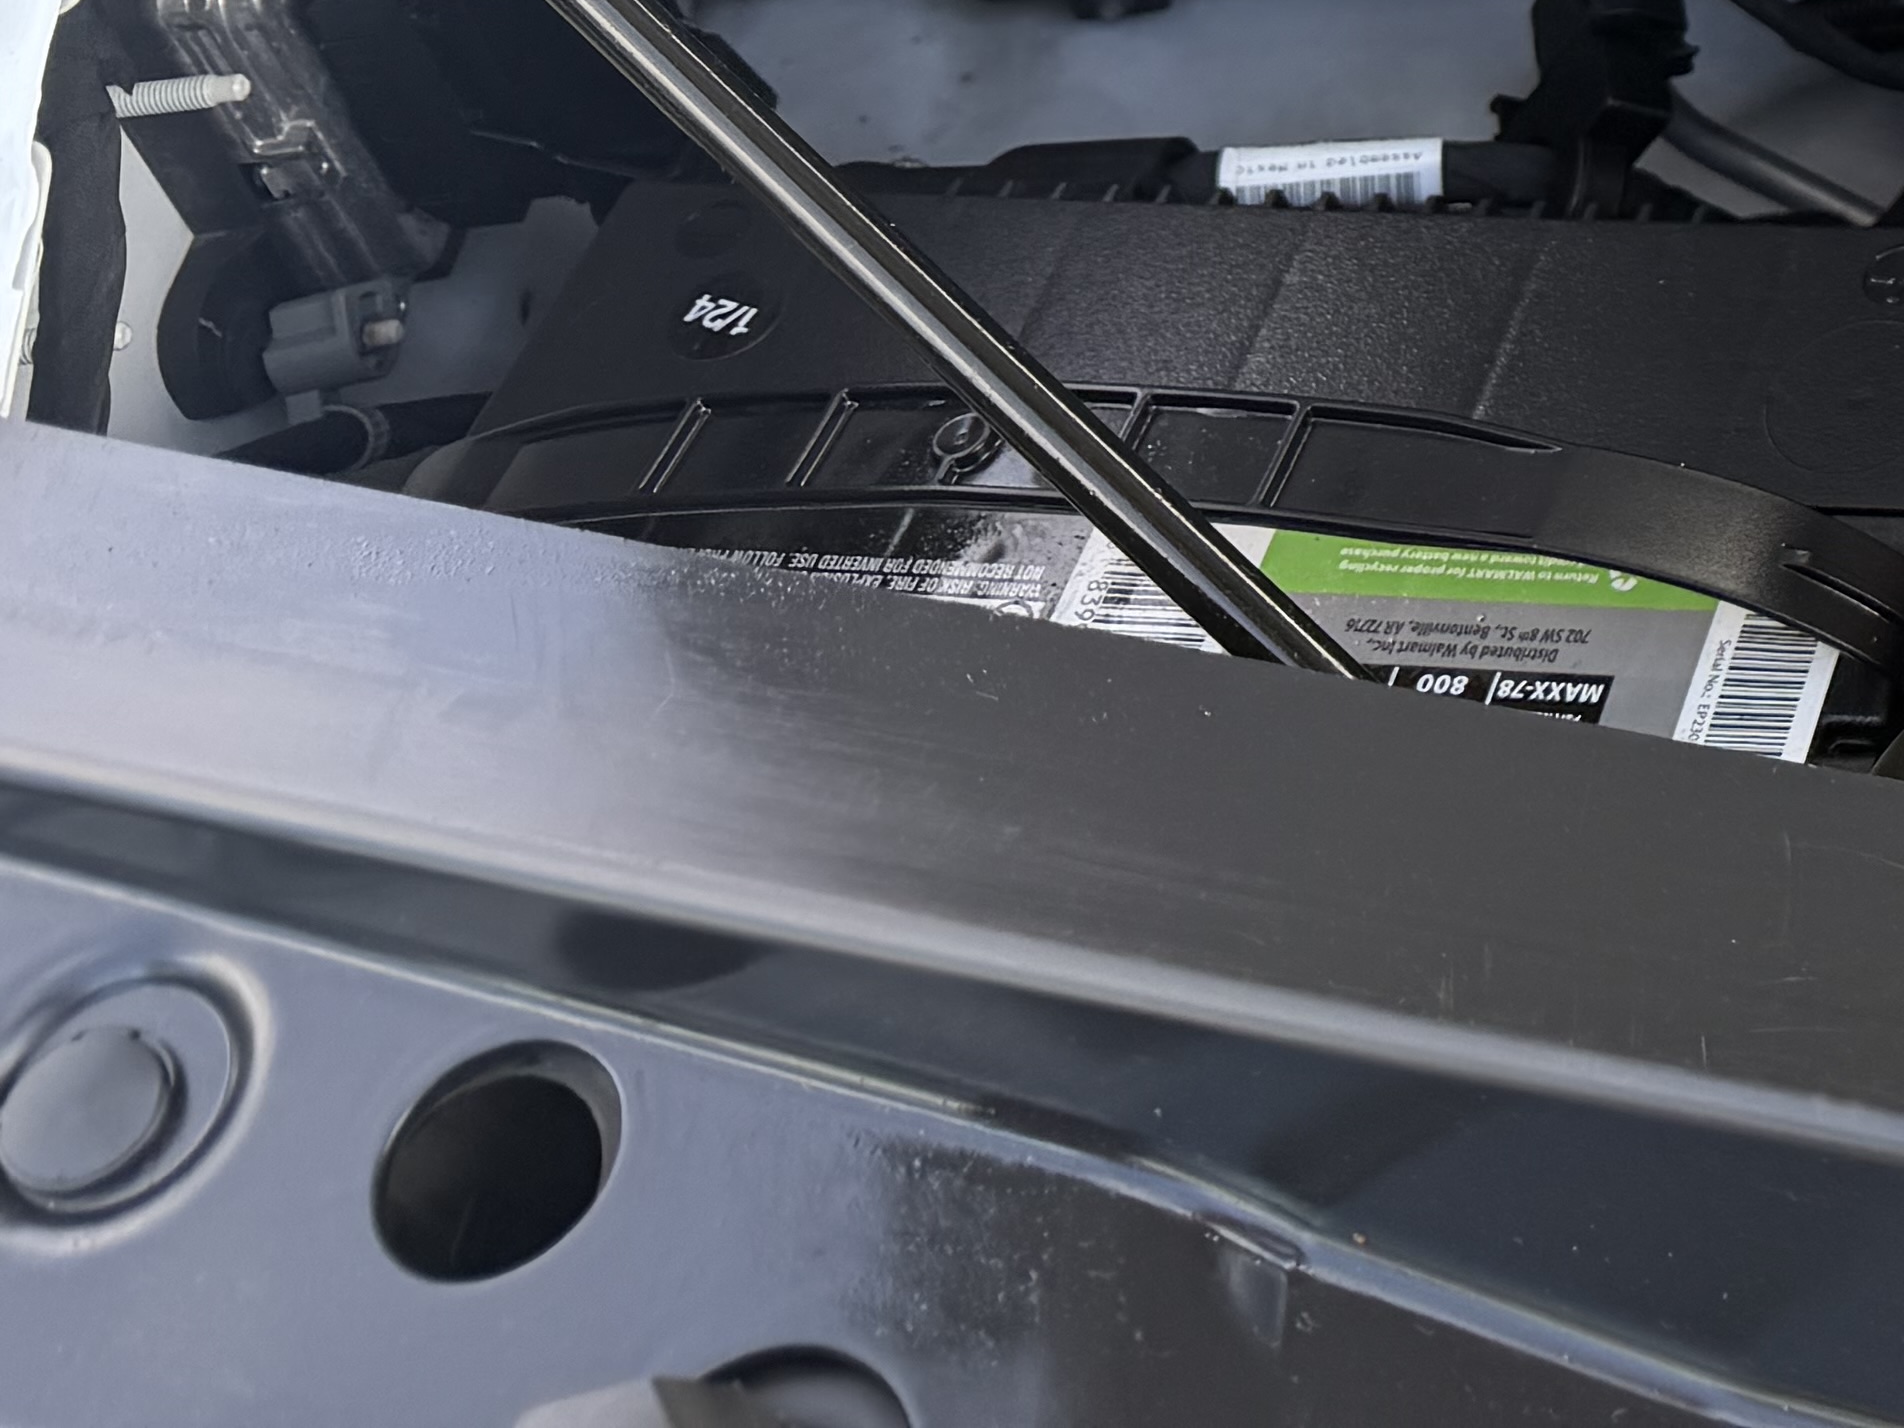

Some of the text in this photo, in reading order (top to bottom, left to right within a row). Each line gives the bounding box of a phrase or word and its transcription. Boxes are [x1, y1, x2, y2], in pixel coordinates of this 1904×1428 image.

[684, 293, 758, 336] 1/24
[886, 558, 911, 573] FOR
[913, 559, 1015, 578] RECOMMENDED
[1019, 565, 1045, 580] NOT
[1339, 559, 1599, 584] Return to WALMART for proper recycling
[920, 577, 937, 592] OF
[941, 578, 972, 594] RISK
[1345, 618, 1384, 634] 72716
[1386, 620, 1405, 635] AR
[1409, 621, 1491, 639] Bentonville,
[1540, 628, 1564, 642] SW
[1566, 628, 1592, 644] 702
[1397, 641, 1457, 657] Walmart
[1461, 642, 1477, 656] by
[1479, 645, 1559, 663] Distributed
[1712, 639, 1732, 672] Serial
[1417, 673, 1605, 704] MAXX-78 800
